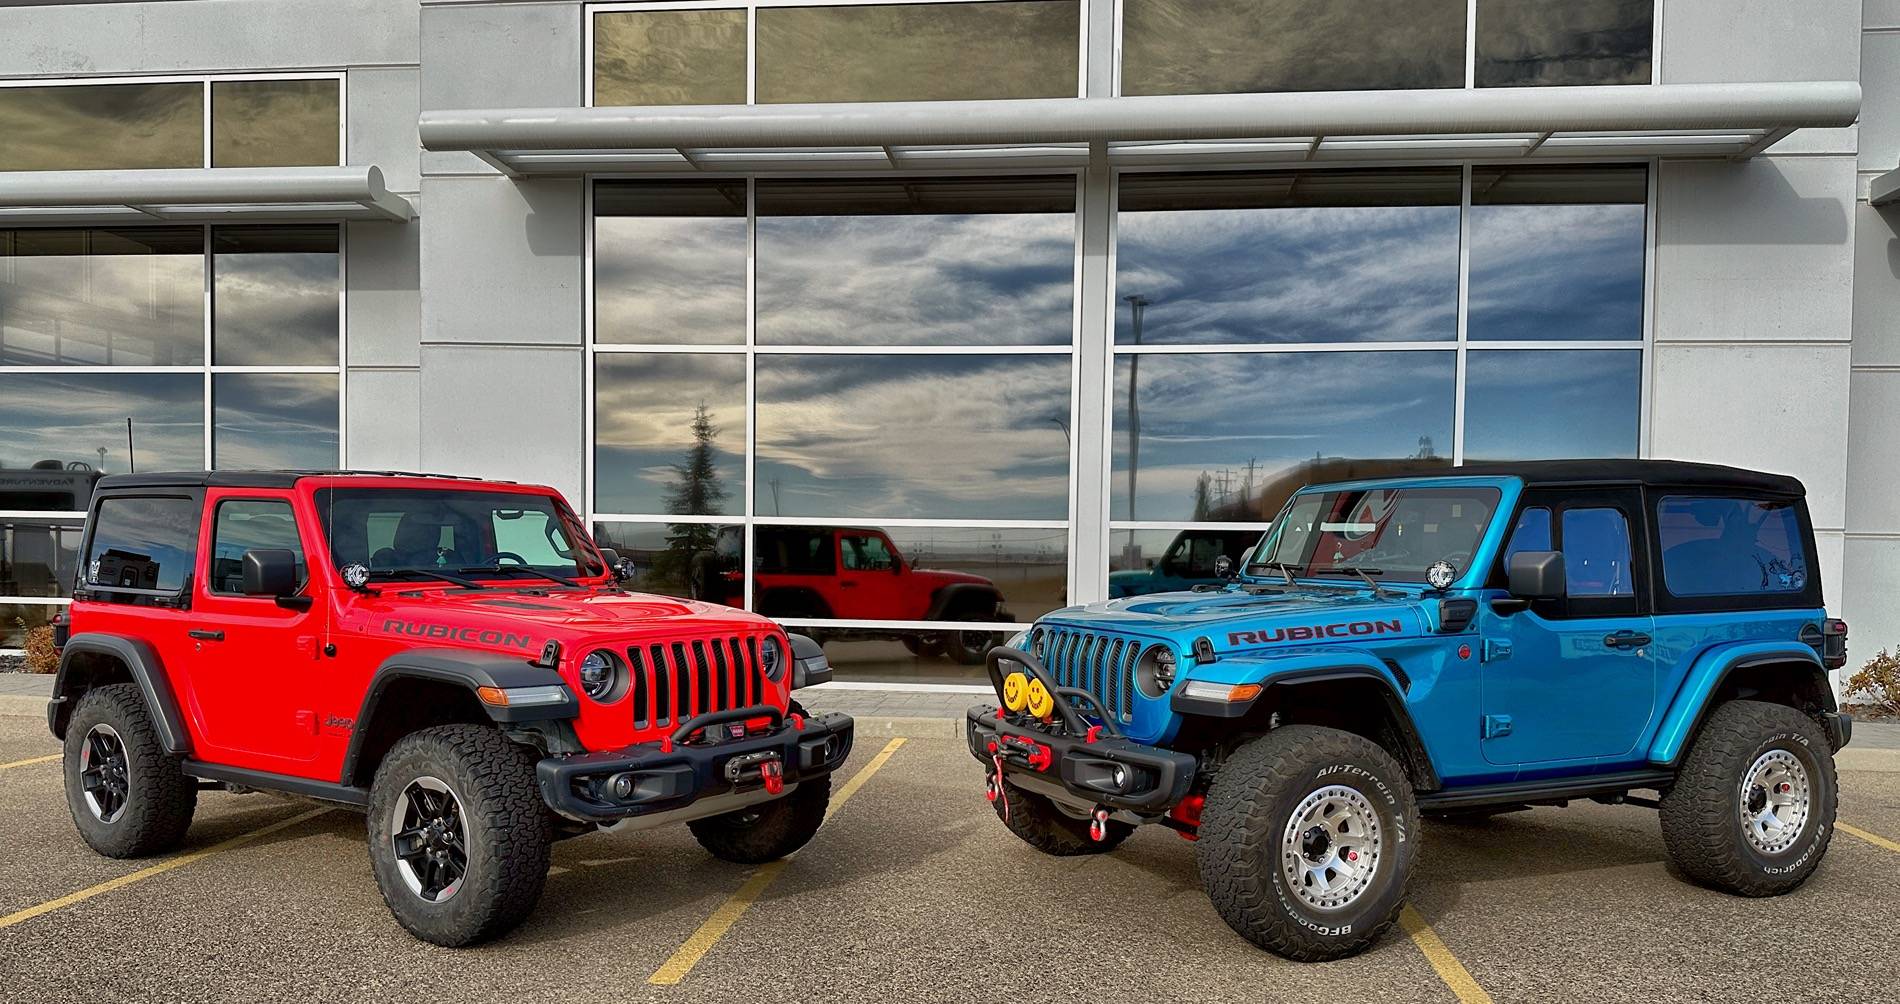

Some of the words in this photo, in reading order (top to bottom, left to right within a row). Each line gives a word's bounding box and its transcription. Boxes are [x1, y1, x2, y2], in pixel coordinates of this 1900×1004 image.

[383, 619, 530, 648] RUBICON
[1227, 620, 1402, 646] RUBICON
[1792, 732, 1809, 746] T/A
[1316, 764, 1395, 805] All-Terrain
[1395, 813, 1406, 843] T/A
[1764, 823, 1825, 875] BFGoodrich
[1273, 872, 1353, 936] BFGoodrich
